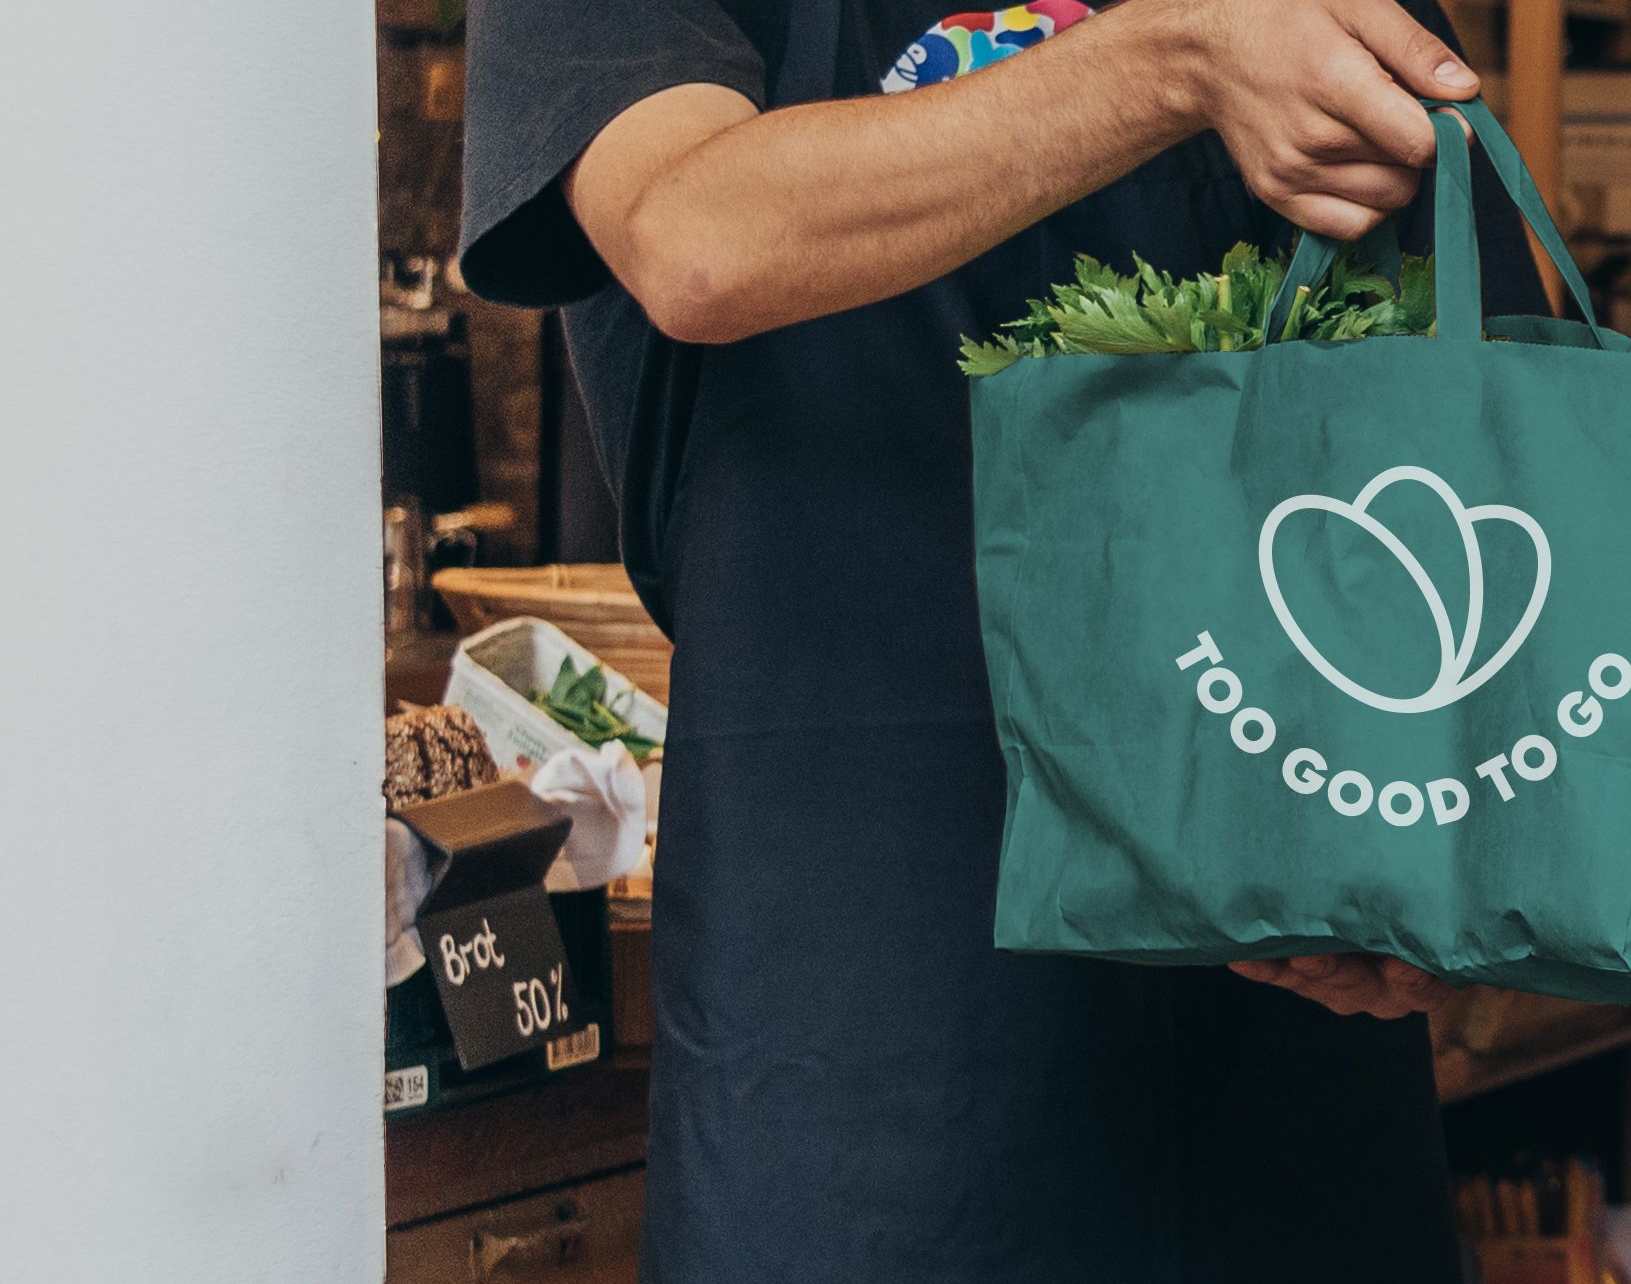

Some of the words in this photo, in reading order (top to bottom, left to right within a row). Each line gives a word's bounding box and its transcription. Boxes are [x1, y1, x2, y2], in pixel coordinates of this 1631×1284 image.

[1175, 630, 1277, 755] TOO
[1282, 747, 1471, 827] GOOD
[1475, 734, 1558, 802] TO
[440, 917, 505, 986] Brot
[512, 962, 569, 1036] 50%
